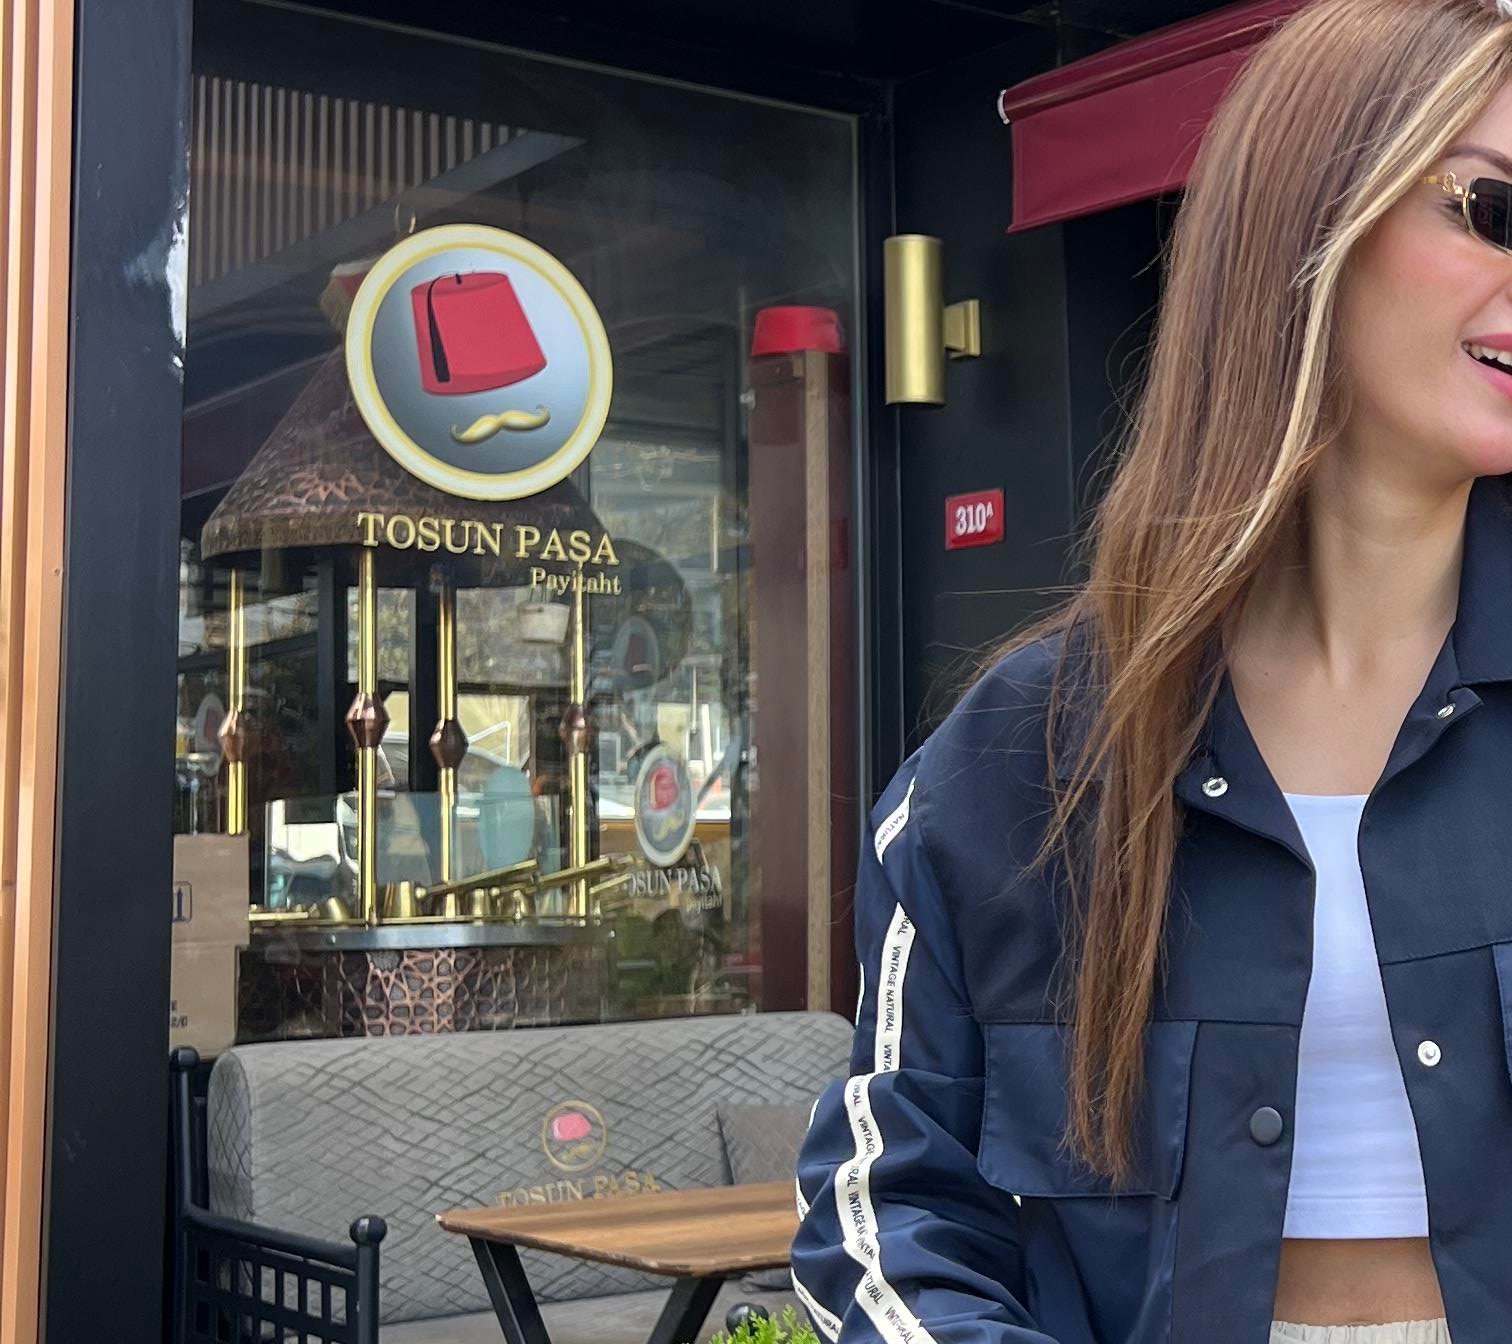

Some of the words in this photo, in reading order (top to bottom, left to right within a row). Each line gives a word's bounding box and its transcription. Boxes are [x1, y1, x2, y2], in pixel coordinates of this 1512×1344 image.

[357, 512, 504, 557] TOSUN
[529, 566, 622, 596] Payitaht
[888, 945, 902, 988] VINTAGE
[884, 989, 895, 1033] NATURAL
[883, 1044, 892, 1071] VINTA
